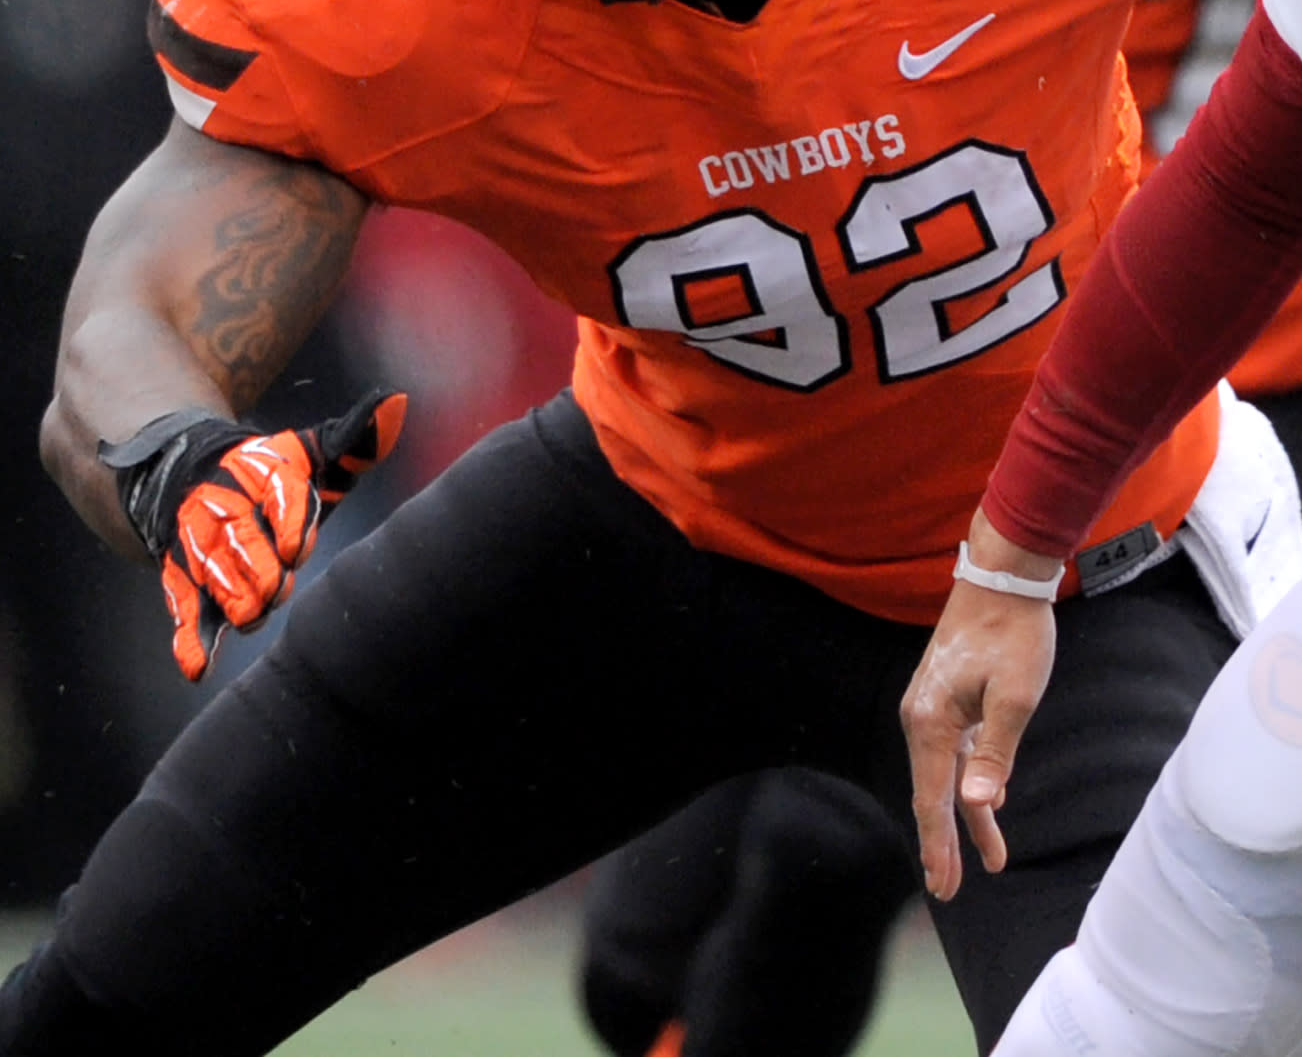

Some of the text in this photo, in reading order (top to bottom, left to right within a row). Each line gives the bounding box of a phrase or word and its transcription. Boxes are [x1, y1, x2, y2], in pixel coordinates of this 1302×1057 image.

[698, 113, 906, 197] COWBOYS
[606, 137, 1068, 394] 92
[1096, 542, 1129, 568] 44
